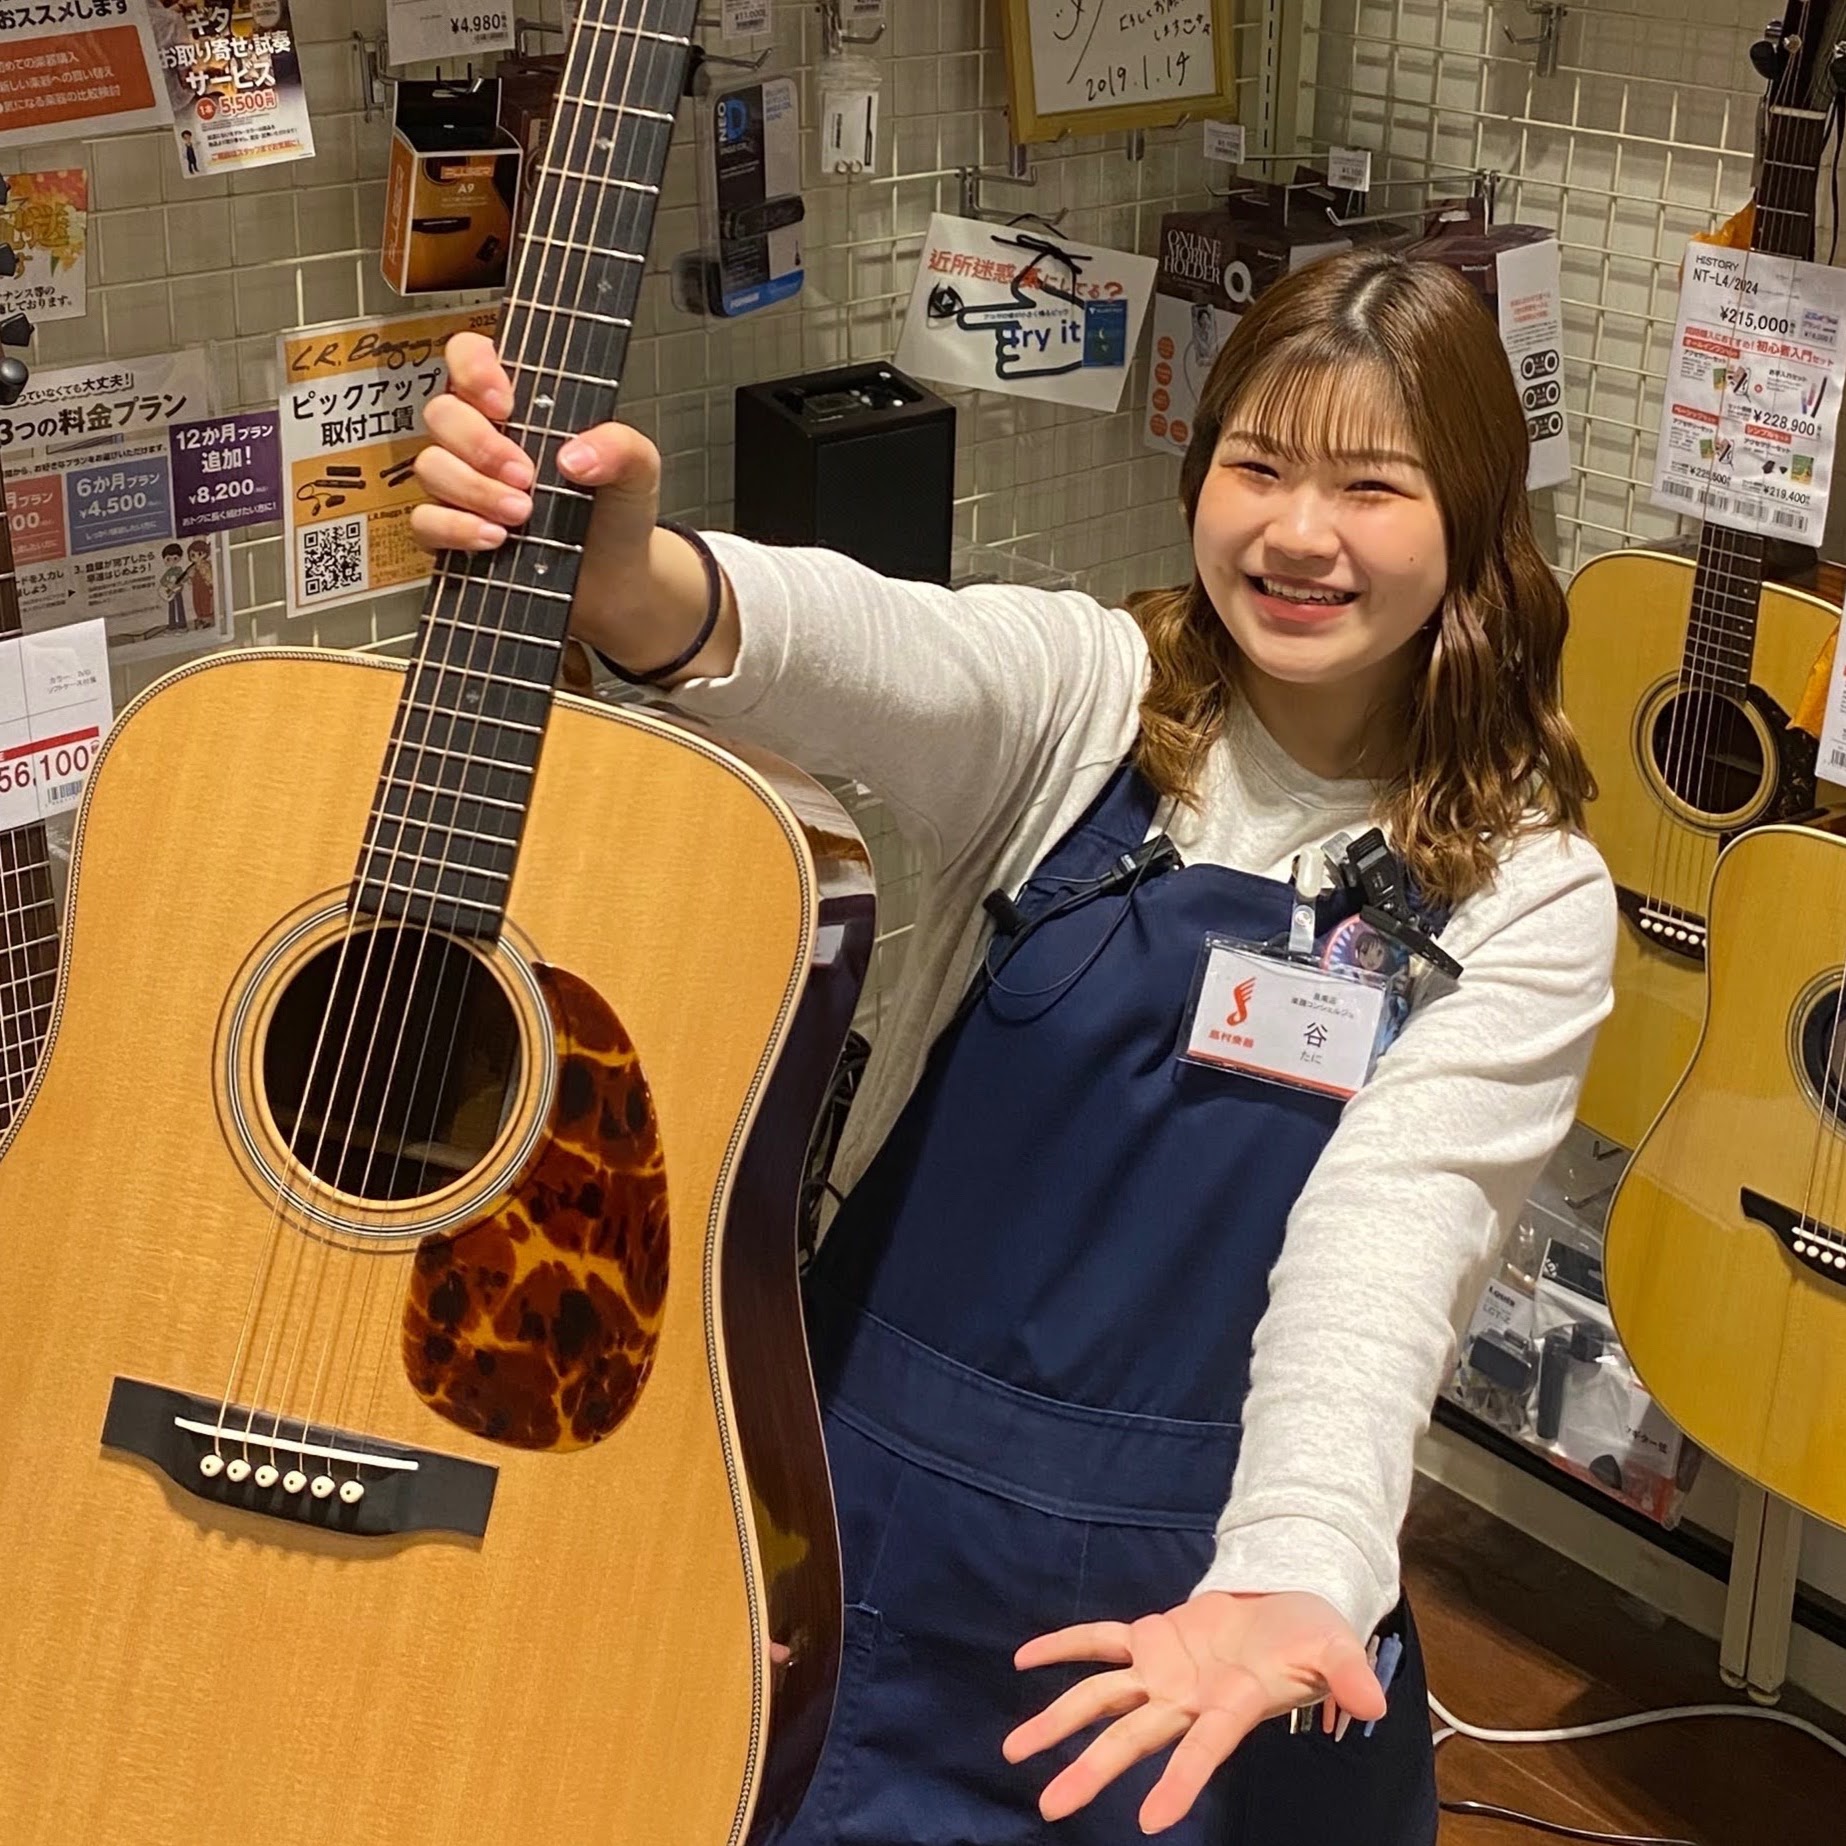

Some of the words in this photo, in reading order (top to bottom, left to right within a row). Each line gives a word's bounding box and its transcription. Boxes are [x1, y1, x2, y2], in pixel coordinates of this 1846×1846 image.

[187, 6, 253, 35] ギター
[186, 61, 276, 96] サービス
[457, 183, 475, 195] A9
[1167, 228, 1222, 254] ONLINE
[1169, 242, 1221, 267] MOBILE
[1163, 255, 1221, 286] HOLDER
[1695, 255, 1740, 272] HISTORY
[1692, 268, 1759, 296] NT-L4/2024
[470, 313, 498, 328] 2025
[1061, 319, 1081, 344] it
[1719, 305, 1789, 335] ¥215,000
[292, 367, 442, 421] ピックアップ
[0, 394, 187, 447] 3つの料金プラン
[320, 405, 415, 447] 取付工賃
[176, 422, 274, 451] 12か月プラン
[201, 445, 252, 474] 追加!
[76, 469, 161, 498] 6か月プラン
[188, 478, 255, 506] ¥8,200
[79, 492, 148, 519] ¥4,500
[9, 512, 41, 532] 00
[1303, 1022, 1328, 1049] 谷
[1300, 1050, 1322, 1065] たに
